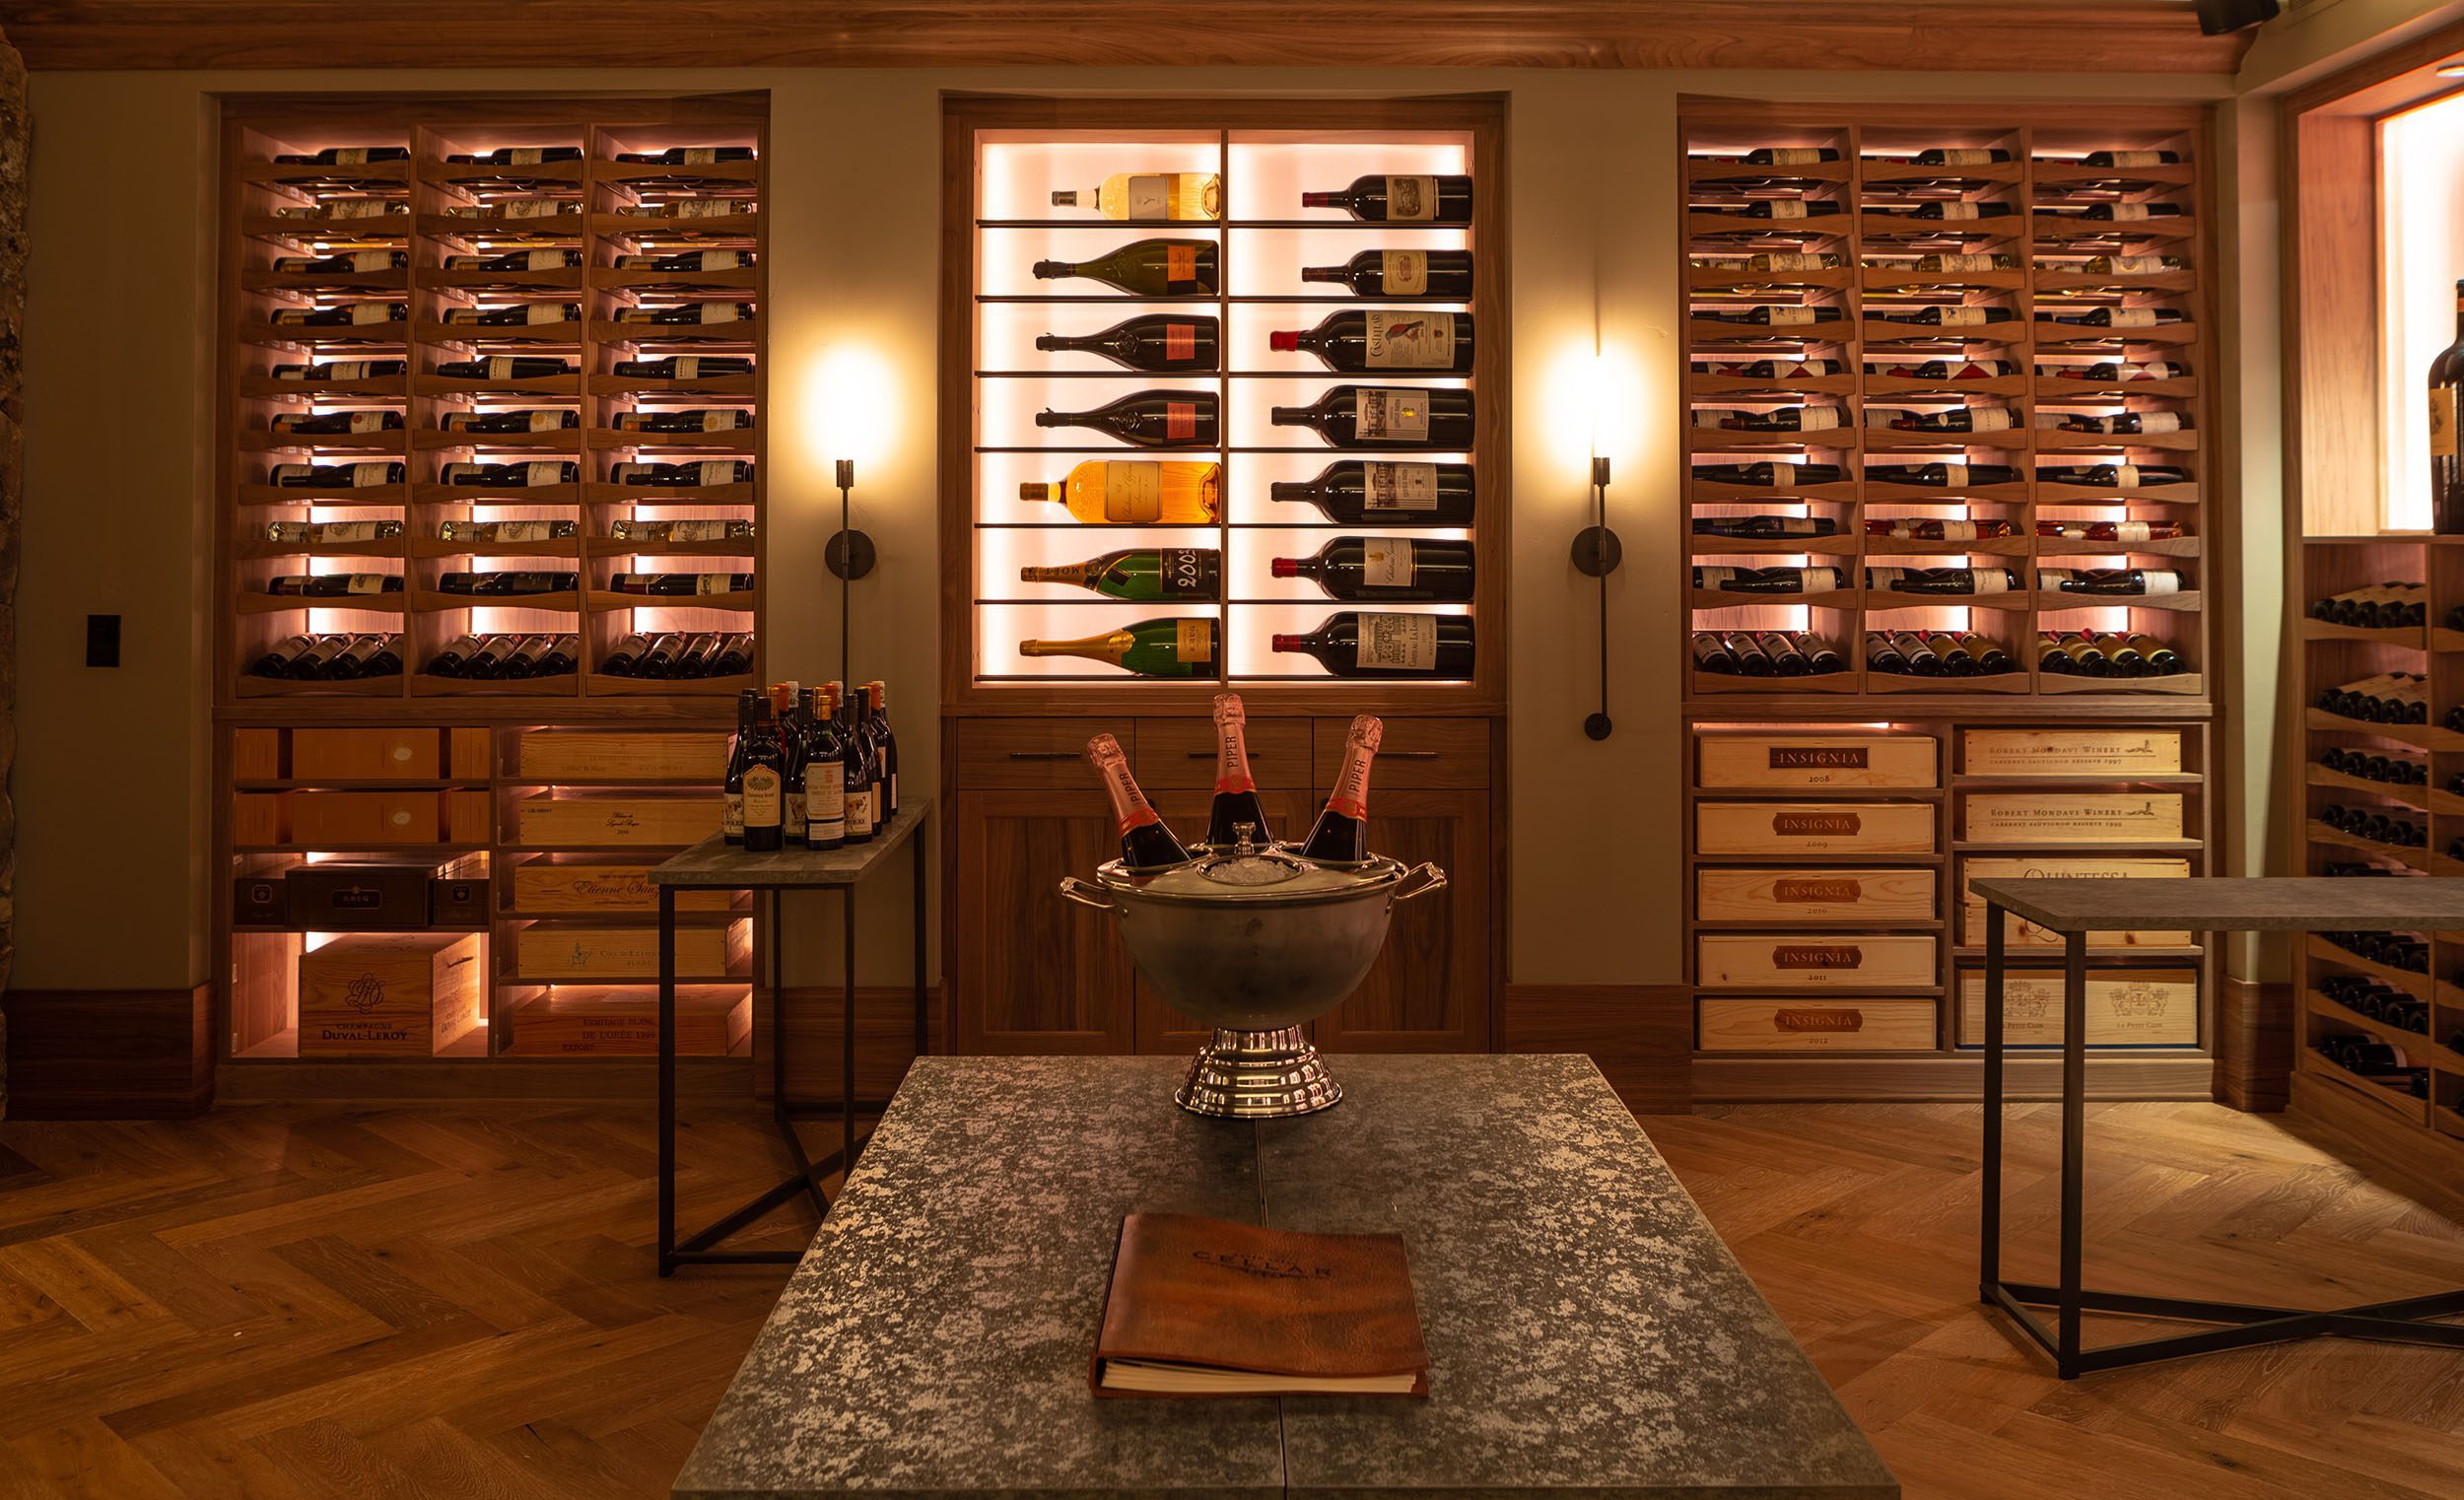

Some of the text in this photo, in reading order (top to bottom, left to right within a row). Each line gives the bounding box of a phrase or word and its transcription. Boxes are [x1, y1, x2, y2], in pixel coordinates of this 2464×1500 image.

[1225, 736, 1239, 768] PIPER
[1780, 752, 1859, 764] INSIGNIA
[1349, 759, 1367, 792] PIPER
[1119, 773, 1139, 802] PIPER
[1784, 819, 1850, 829] INSIGNIA
[1784, 886, 1850, 897] INSIGNIA
[1784, 952, 1852, 963] INSIGNIA
[582, 1017, 625, 1026] ERMITAGE
[1785, 1016, 1853, 1026] INSIGNIA
[321, 1030, 407, 1042] DUVAL-LEROY
[1193, 1251, 1332, 1276] CELLAR
